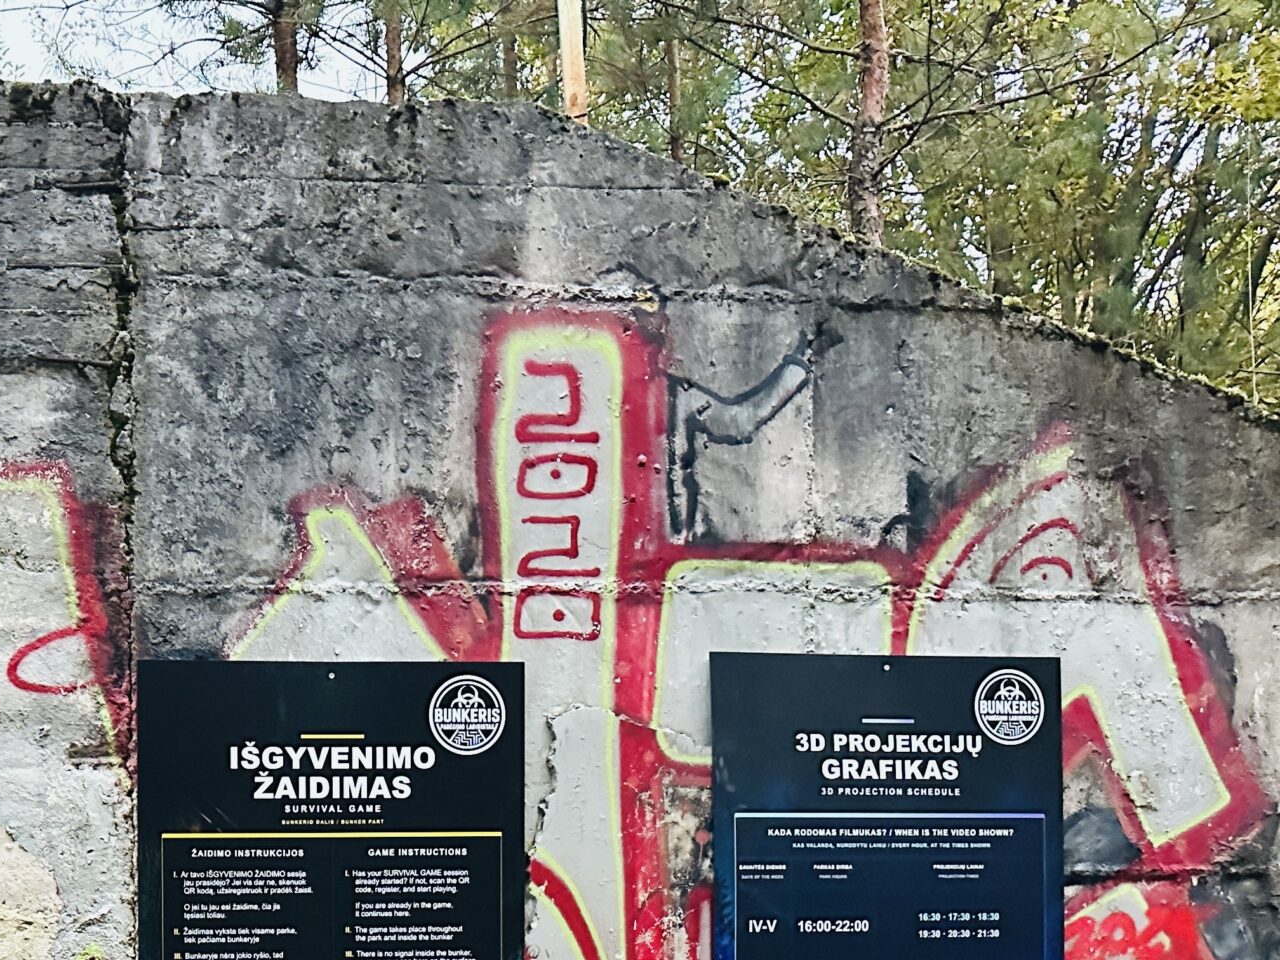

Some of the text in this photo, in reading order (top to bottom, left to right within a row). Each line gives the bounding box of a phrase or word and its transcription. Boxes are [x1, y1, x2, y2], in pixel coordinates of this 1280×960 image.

[980, 699, 1039, 715] BUNKERIS
[434, 708, 501, 724] BUNKERIS
[795, 734, 982, 757] 3D PROJEKCIJŲ
[230, 741, 436, 770] IŠGYVENIMO
[821, 758, 959, 781] GRAFIKAS
[253, 771, 412, 799] ŽAIDIMAS
[821, 787, 960, 796] 3D PROJECTION SCHEDULE
[285, 804, 381, 813] SURVIVAL GAME
[768, 828, 792, 836] KADA
[794, 828, 837, 836] RODOMAS
[951, 829, 976, 837] VIDEO
[191, 848, 304, 858] ŽAIDIMO INSTRUKCIJOS
[368, 847, 467, 857] GAME INSTRUCTIONS
[384, 869, 418, 877] SURVIVAL
[420, 868, 441, 876] GAME
[183, 879, 194, 888] jau
[355, 878, 379, 886] already
[381, 877, 408, 885] started?
[415, 877, 428, 885] not,
[458, 876, 470, 884] QR
[375, 886, 401, 895] register,
[403, 885, 415, 893] and
[433, 886, 459, 894] playing.
[362, 903, 374, 911] you
[388, 902, 411, 910] already
[433, 902, 455, 910] game,
[918, 912, 1000, 921] 16:30 17:30 18:30
[749, 919, 777, 933] IV-V
[798, 920, 869, 932] 16:00-22:00
[918, 929, 1000, 938] 19:30 20:30 21:30
